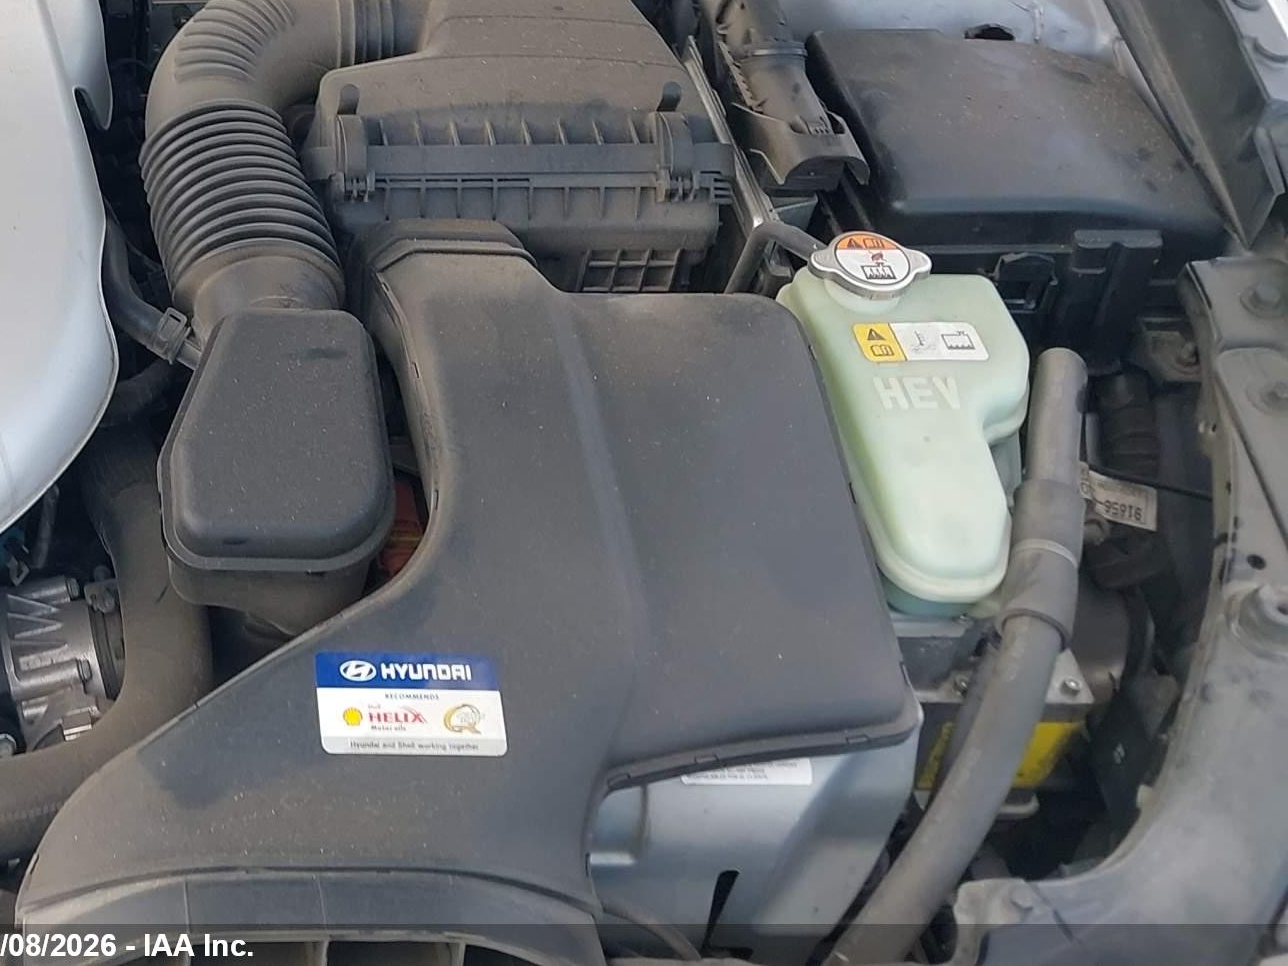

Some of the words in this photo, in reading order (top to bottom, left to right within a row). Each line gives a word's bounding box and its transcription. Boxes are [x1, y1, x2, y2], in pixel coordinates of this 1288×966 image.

[873, 376, 960, 410] HEV
[380, 662, 473, 682] HYUNDAI
[385, 693, 440, 701] RECOMMENDS
[368, 711, 426, 724] HELIX
[350, 740, 380, 750] Hyundai
[417, 742, 447, 751] working
[449, 743, 479, 752] together
